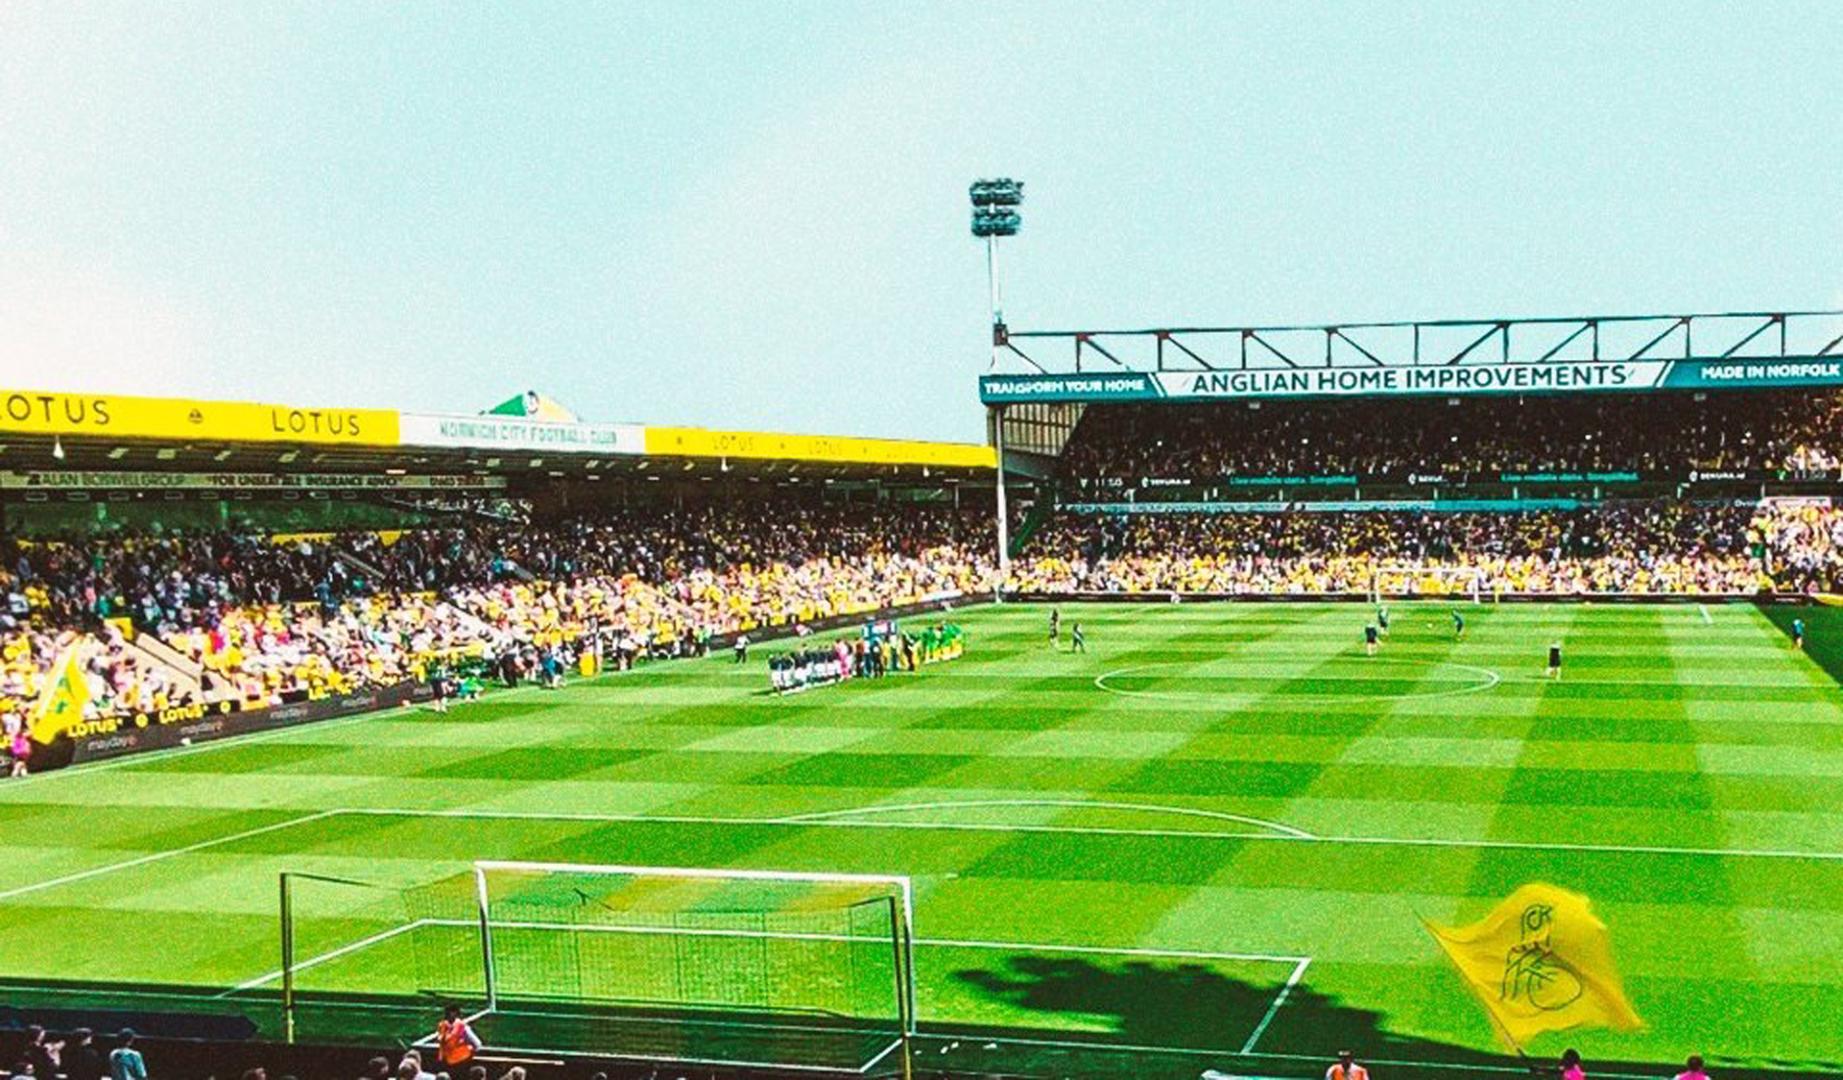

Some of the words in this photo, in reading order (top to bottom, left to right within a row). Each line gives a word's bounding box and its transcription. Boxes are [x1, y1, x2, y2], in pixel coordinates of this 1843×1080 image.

[1192, 372, 1309, 392] ANGLIAN
[1318, 370, 1397, 390] HOME
[1406, 365, 1627, 388] IMPROVEMENTS
[1701, 366, 1744, 379] MADE
[1747, 366, 1764, 378] IN
[1767, 363, 1840, 377] NORFOLK
[1066, 380, 1101, 392] YOUR
[1105, 379, 1145, 391] HOME
[0, 394, 110, 425] OTUS
[271, 409, 360, 436] LOTUS
[440, 421, 496, 439] NORWICH
[501, 425, 527, 440] CITY
[530, 427, 587, 443] FOOTBALL
[159, 705, 203, 724] LOTUS
[68, 718, 117, 737] LOTUS
